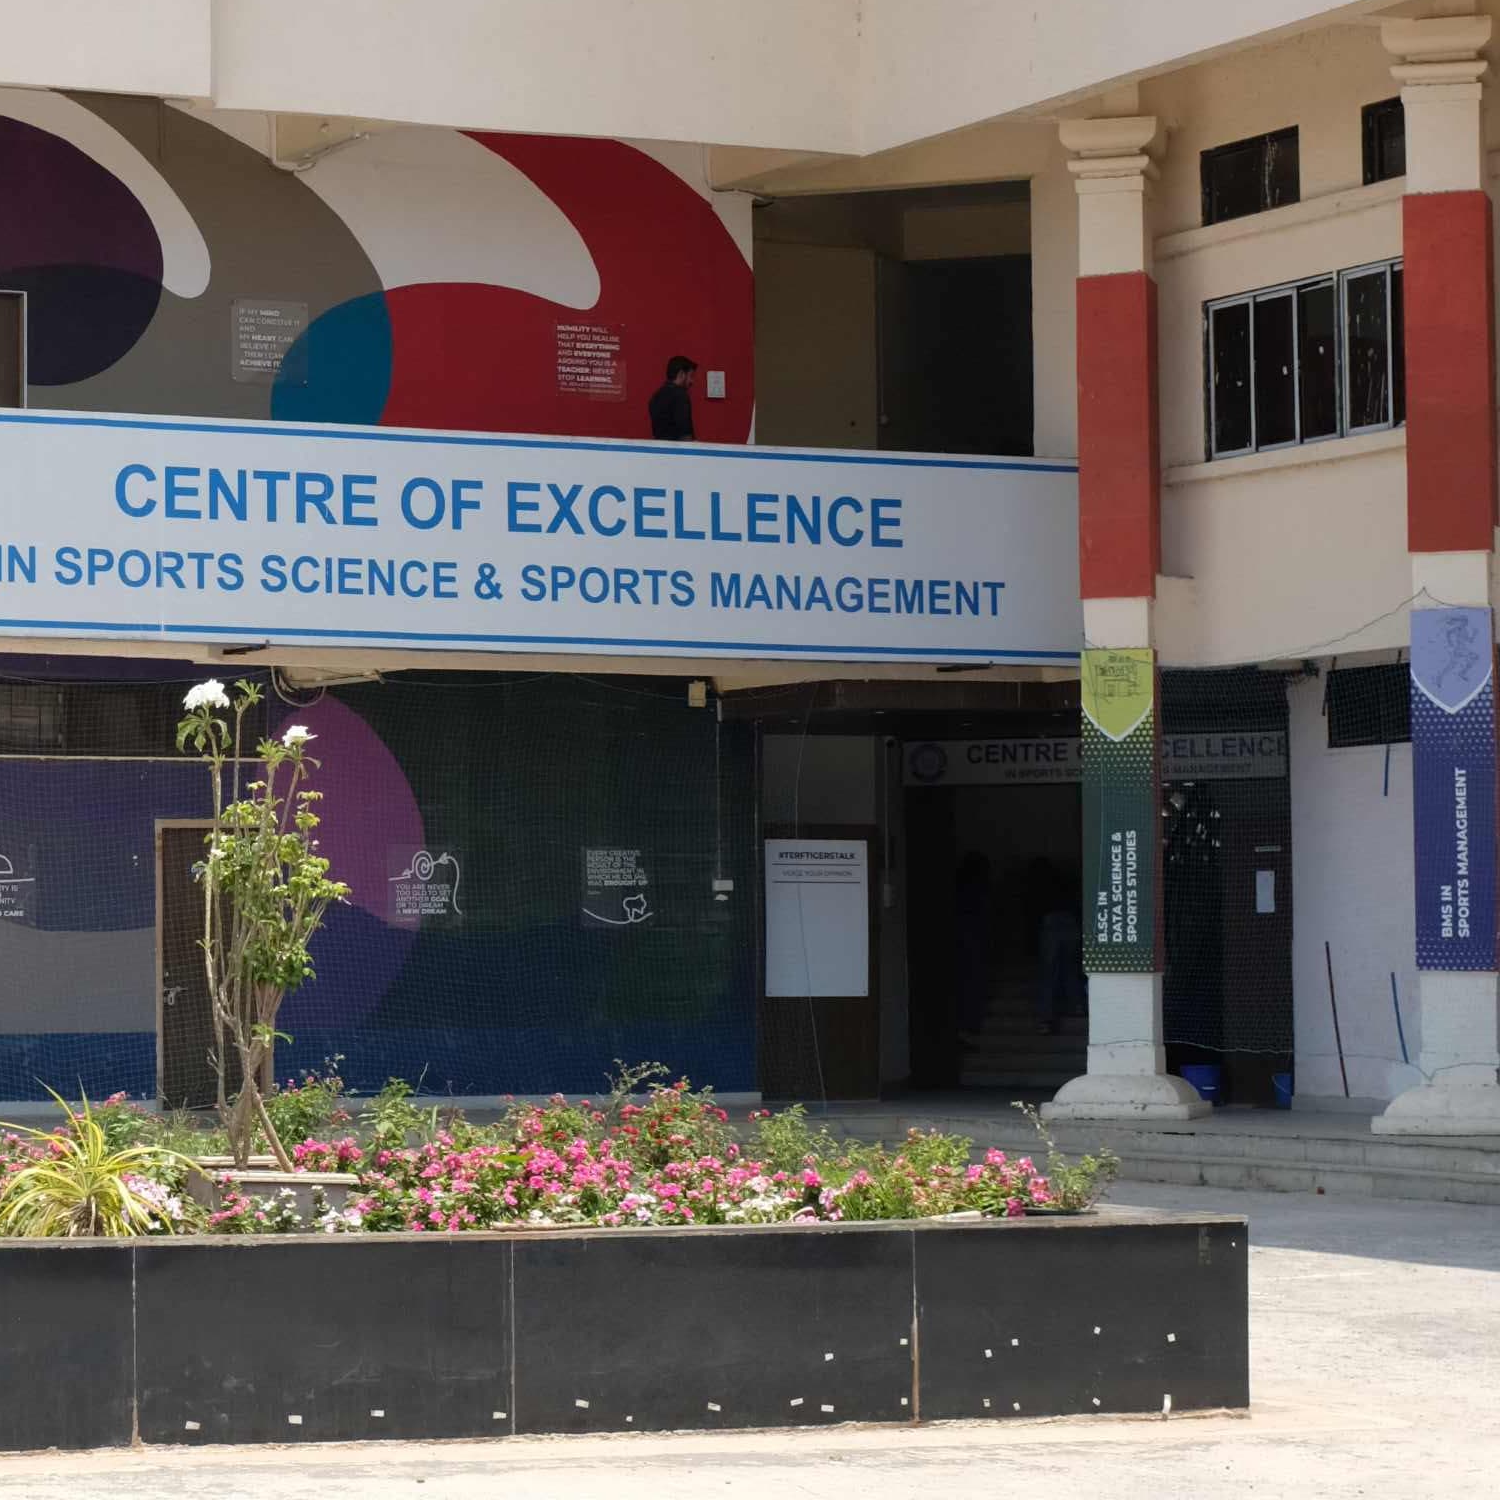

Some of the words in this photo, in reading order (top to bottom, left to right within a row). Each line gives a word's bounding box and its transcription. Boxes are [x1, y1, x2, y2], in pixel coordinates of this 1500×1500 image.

[114, 463, 380, 527] CENTRE
[400, 477, 484, 531] OF
[507, 480, 904, 549] EXCELLENCE
[55, 547, 244, 592] SPORTS
[261, 554, 458, 600] SCIENCE
[474, 563, 503, 601] &
[521, 564, 696, 608] SPORTS
[710, 572, 1006, 617] MANAGEMENT
[966, 743, 1069, 764] CENTRE
[1111, 832, 1122, 841] &
[1454, 767, 1469, 875] MANAGEMENT
[1111, 845, 1123, 902] SCIENCE
[1126, 830, 1137, 887] STUDIES
[1097, 891, 1108, 906] IN
[1126, 889, 1138, 942] SPORTS
[1441, 884, 1453, 901] IN
[1457, 878, 1470, 938] SPORTS
[1112, 904, 1123, 942] DATA
[1441, 904, 1453, 938] BMS
